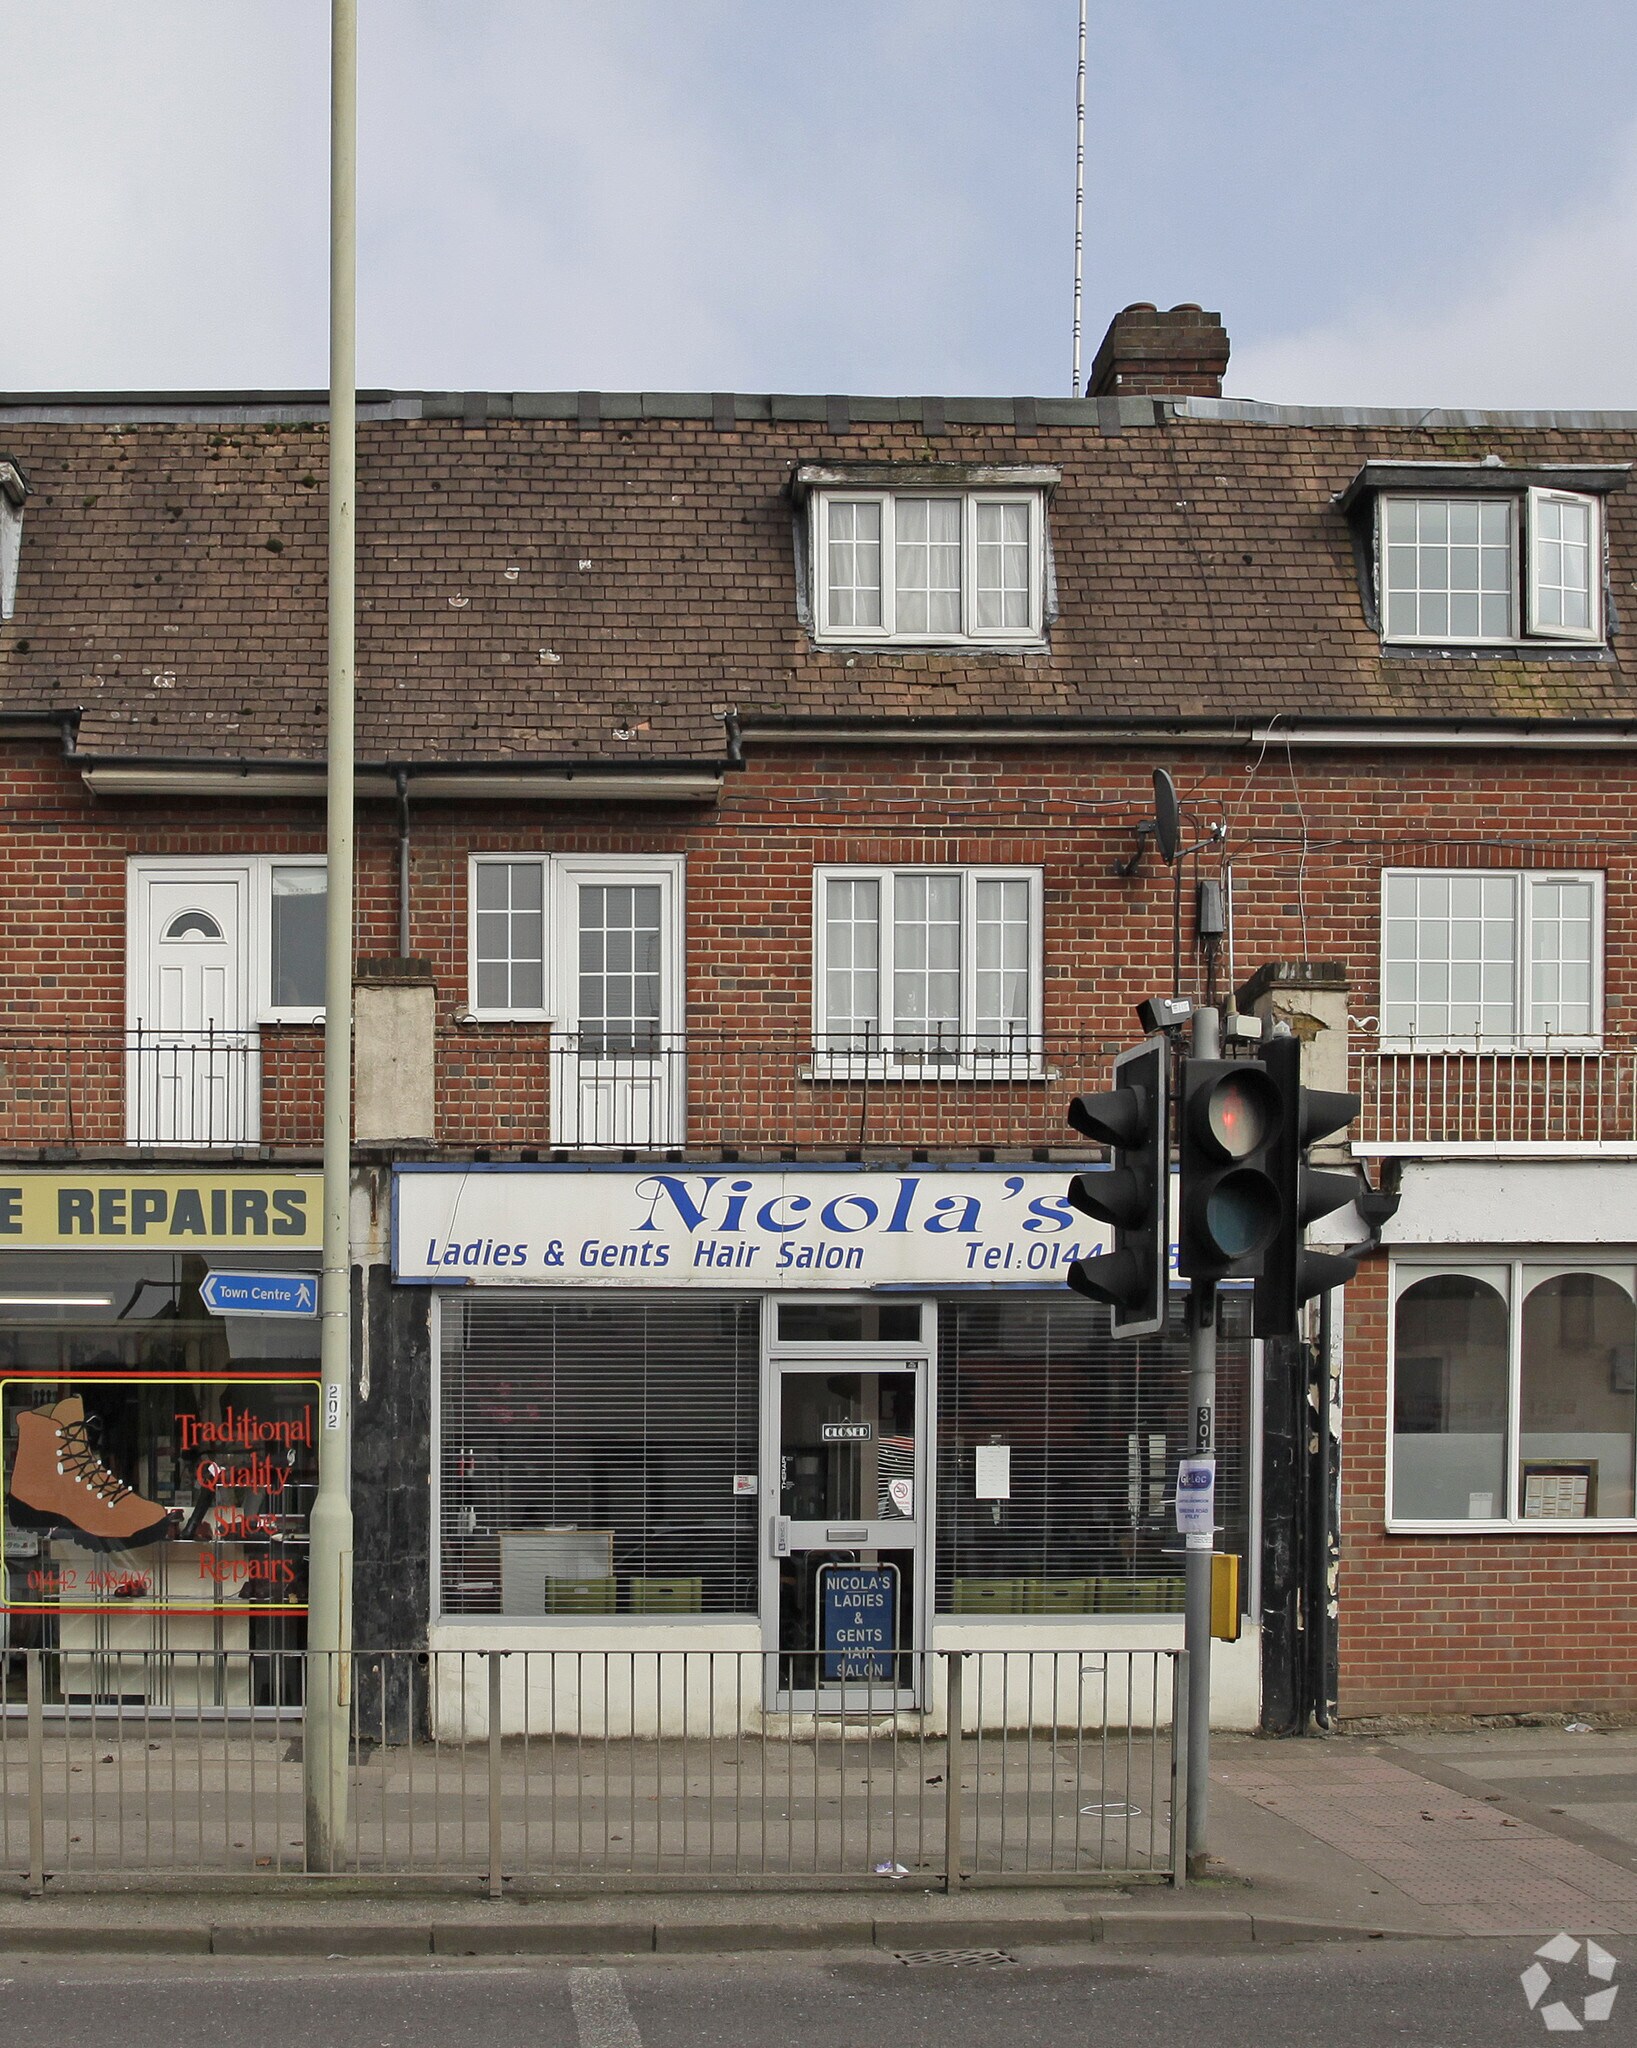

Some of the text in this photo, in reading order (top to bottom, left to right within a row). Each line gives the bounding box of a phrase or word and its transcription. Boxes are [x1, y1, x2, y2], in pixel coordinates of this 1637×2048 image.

[57, 1188, 307, 1236] REPAIRS
[630, 1175, 1073, 1234] Nicola's
[426, 1238, 529, 1266] Ladies
[543, 1239, 565, 1267] &
[579, 1239, 671, 1268] Gents
[693, 1240, 761, 1268] Hair
[775, 1241, 865, 1270] Salon
[219, 1285, 292, 1301] Town Centre
[328, 1385, 338, 1428] 202
[174, 1404, 312, 1451] Traditional
[824, 1426, 868, 1438] CLOSED
[1199, 1408, 1209, 1453] 301
[195, 1451, 293, 1496] Quality
[212, 1505, 279, 1539] Shoe
[26, 1568, 153, 1592] 01442 408406
[198, 1551, 297, 1583] Repairs
[826, 1576, 891, 1590] NICOLA'S
[834, 1594, 884, 1607] LADIES
[854, 1611, 863, 1624] &
[836, 1629, 883, 1642] GENTS
